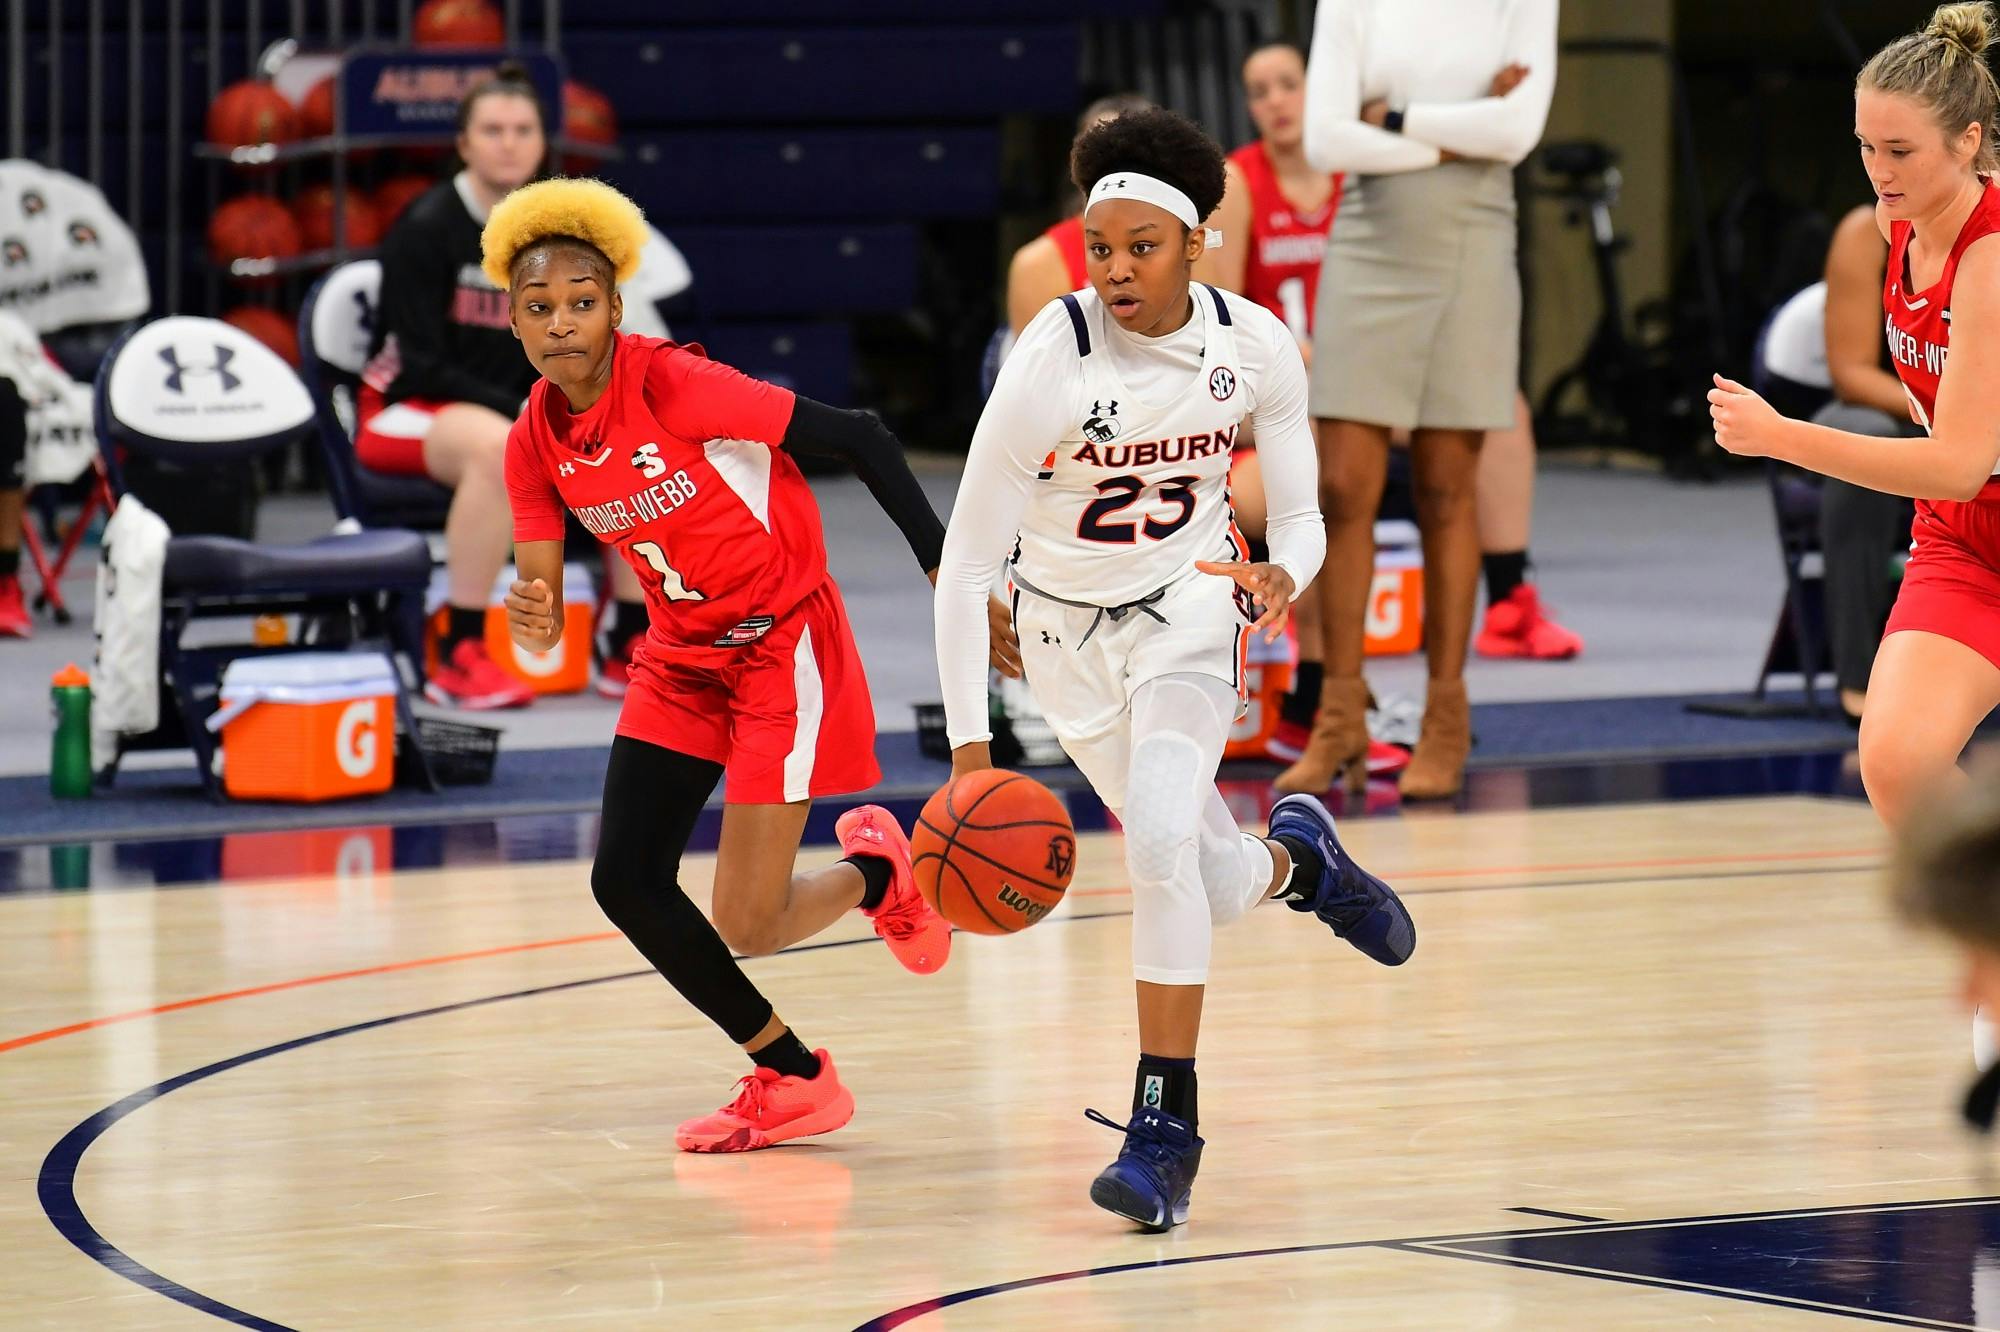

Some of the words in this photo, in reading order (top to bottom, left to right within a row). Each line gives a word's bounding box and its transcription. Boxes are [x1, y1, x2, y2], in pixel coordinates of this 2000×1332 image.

[1210, 367, 1235, 400] SEC
[1071, 423, 1237, 468] AUBURN
[569, 469, 698, 535] ARDNER-WEBB
[1077, 474, 1203, 545] 23
[335, 700, 378, 778] G
